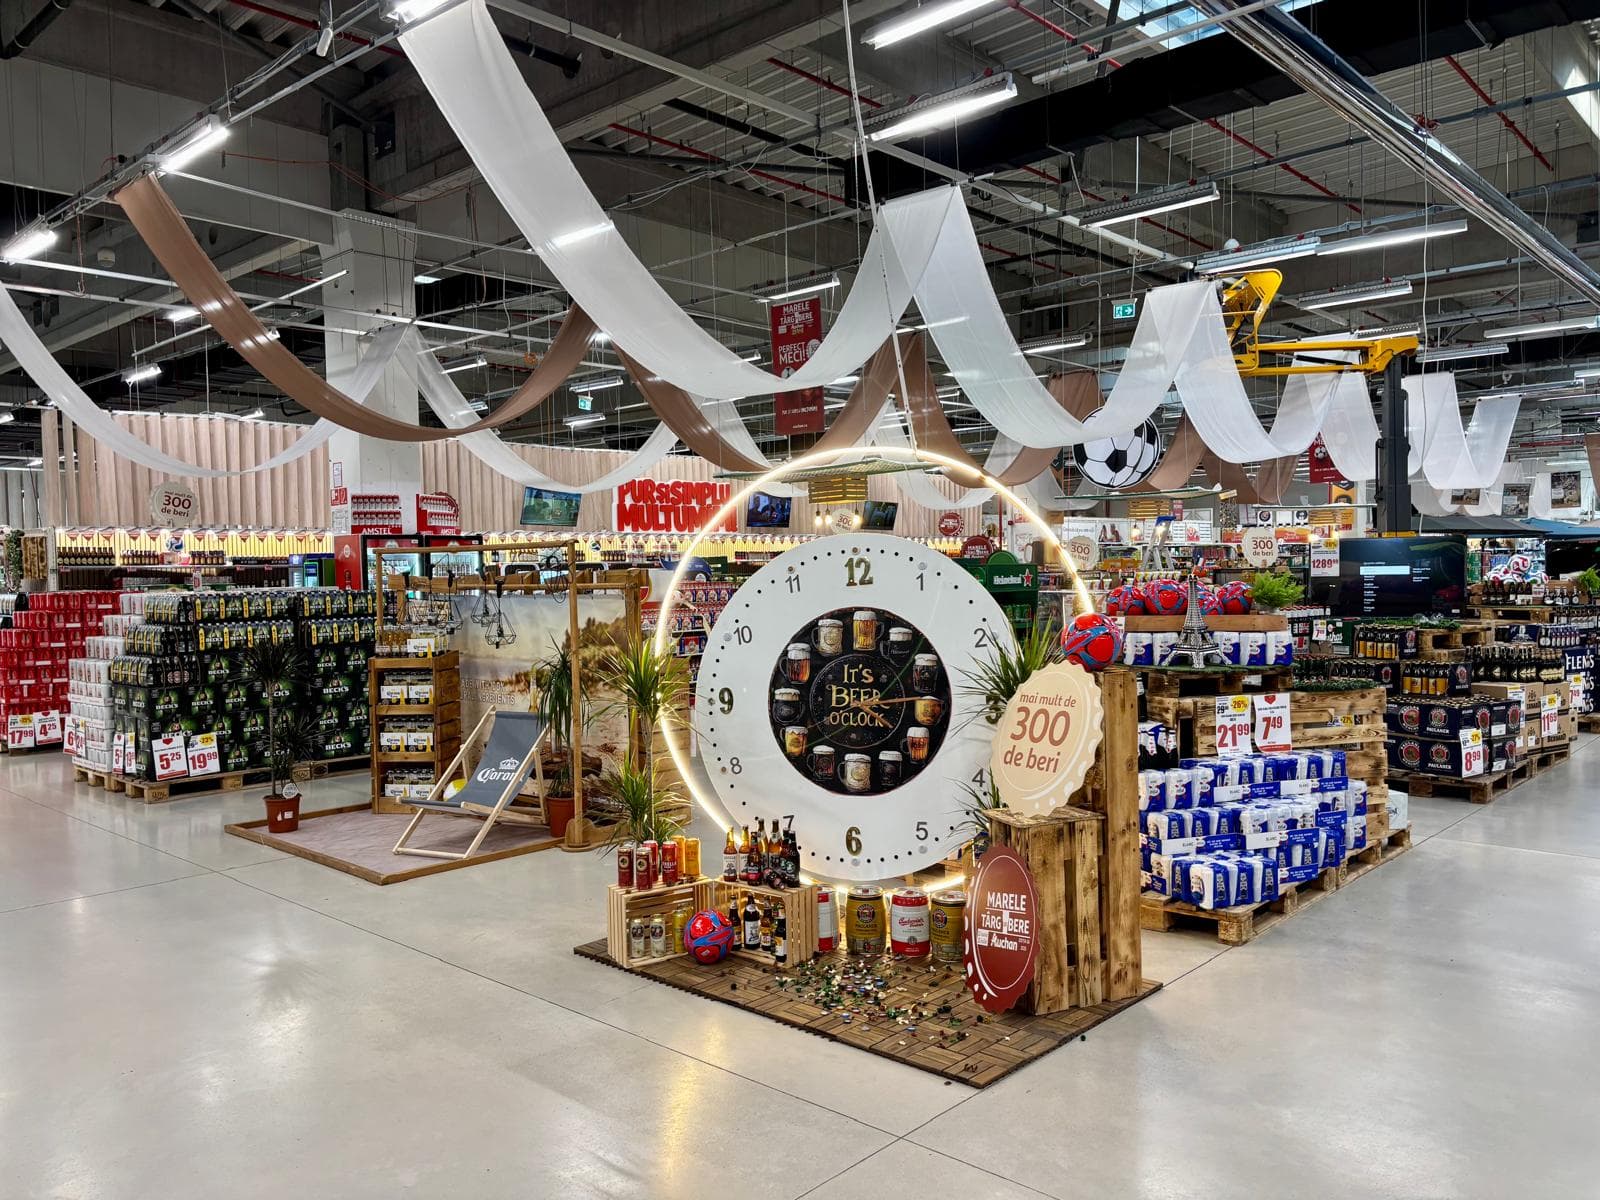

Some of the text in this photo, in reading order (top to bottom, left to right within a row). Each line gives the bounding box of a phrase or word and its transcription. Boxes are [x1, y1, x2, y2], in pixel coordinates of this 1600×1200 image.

[783, 302, 811, 314] MARELE
[778, 342, 806, 353] PERFECT
[163, 494, 191, 509] 300
[173, 509, 189, 517] beri
[1071, 544, 1090, 554] 300
[1252, 540, 1273, 550] 300
[844, 557, 874, 586] 12
[993, 574, 1021, 584] Heineken
[785, 574, 800, 593] 11
[916, 573, 924, 591] 1
[733, 625, 752, 645] 10
[973, 628, 987, 648] 2
[718, 688, 734, 714] 9
[1020, 692, 1077, 708] mai mult de
[1010, 706, 1071, 747] 300
[730, 757, 742, 775] 8
[1003, 745, 1061, 773] de beri
[972, 768, 986, 787] 4
[783, 815, 795, 830] 7
[915, 822, 928, 841] 5
[845, 826, 862, 856] 6
[987, 891, 1027, 912] MARELE
[981, 911, 1030, 935] TÂRG BERE
[991, 932, 1018, 951] Auchan
